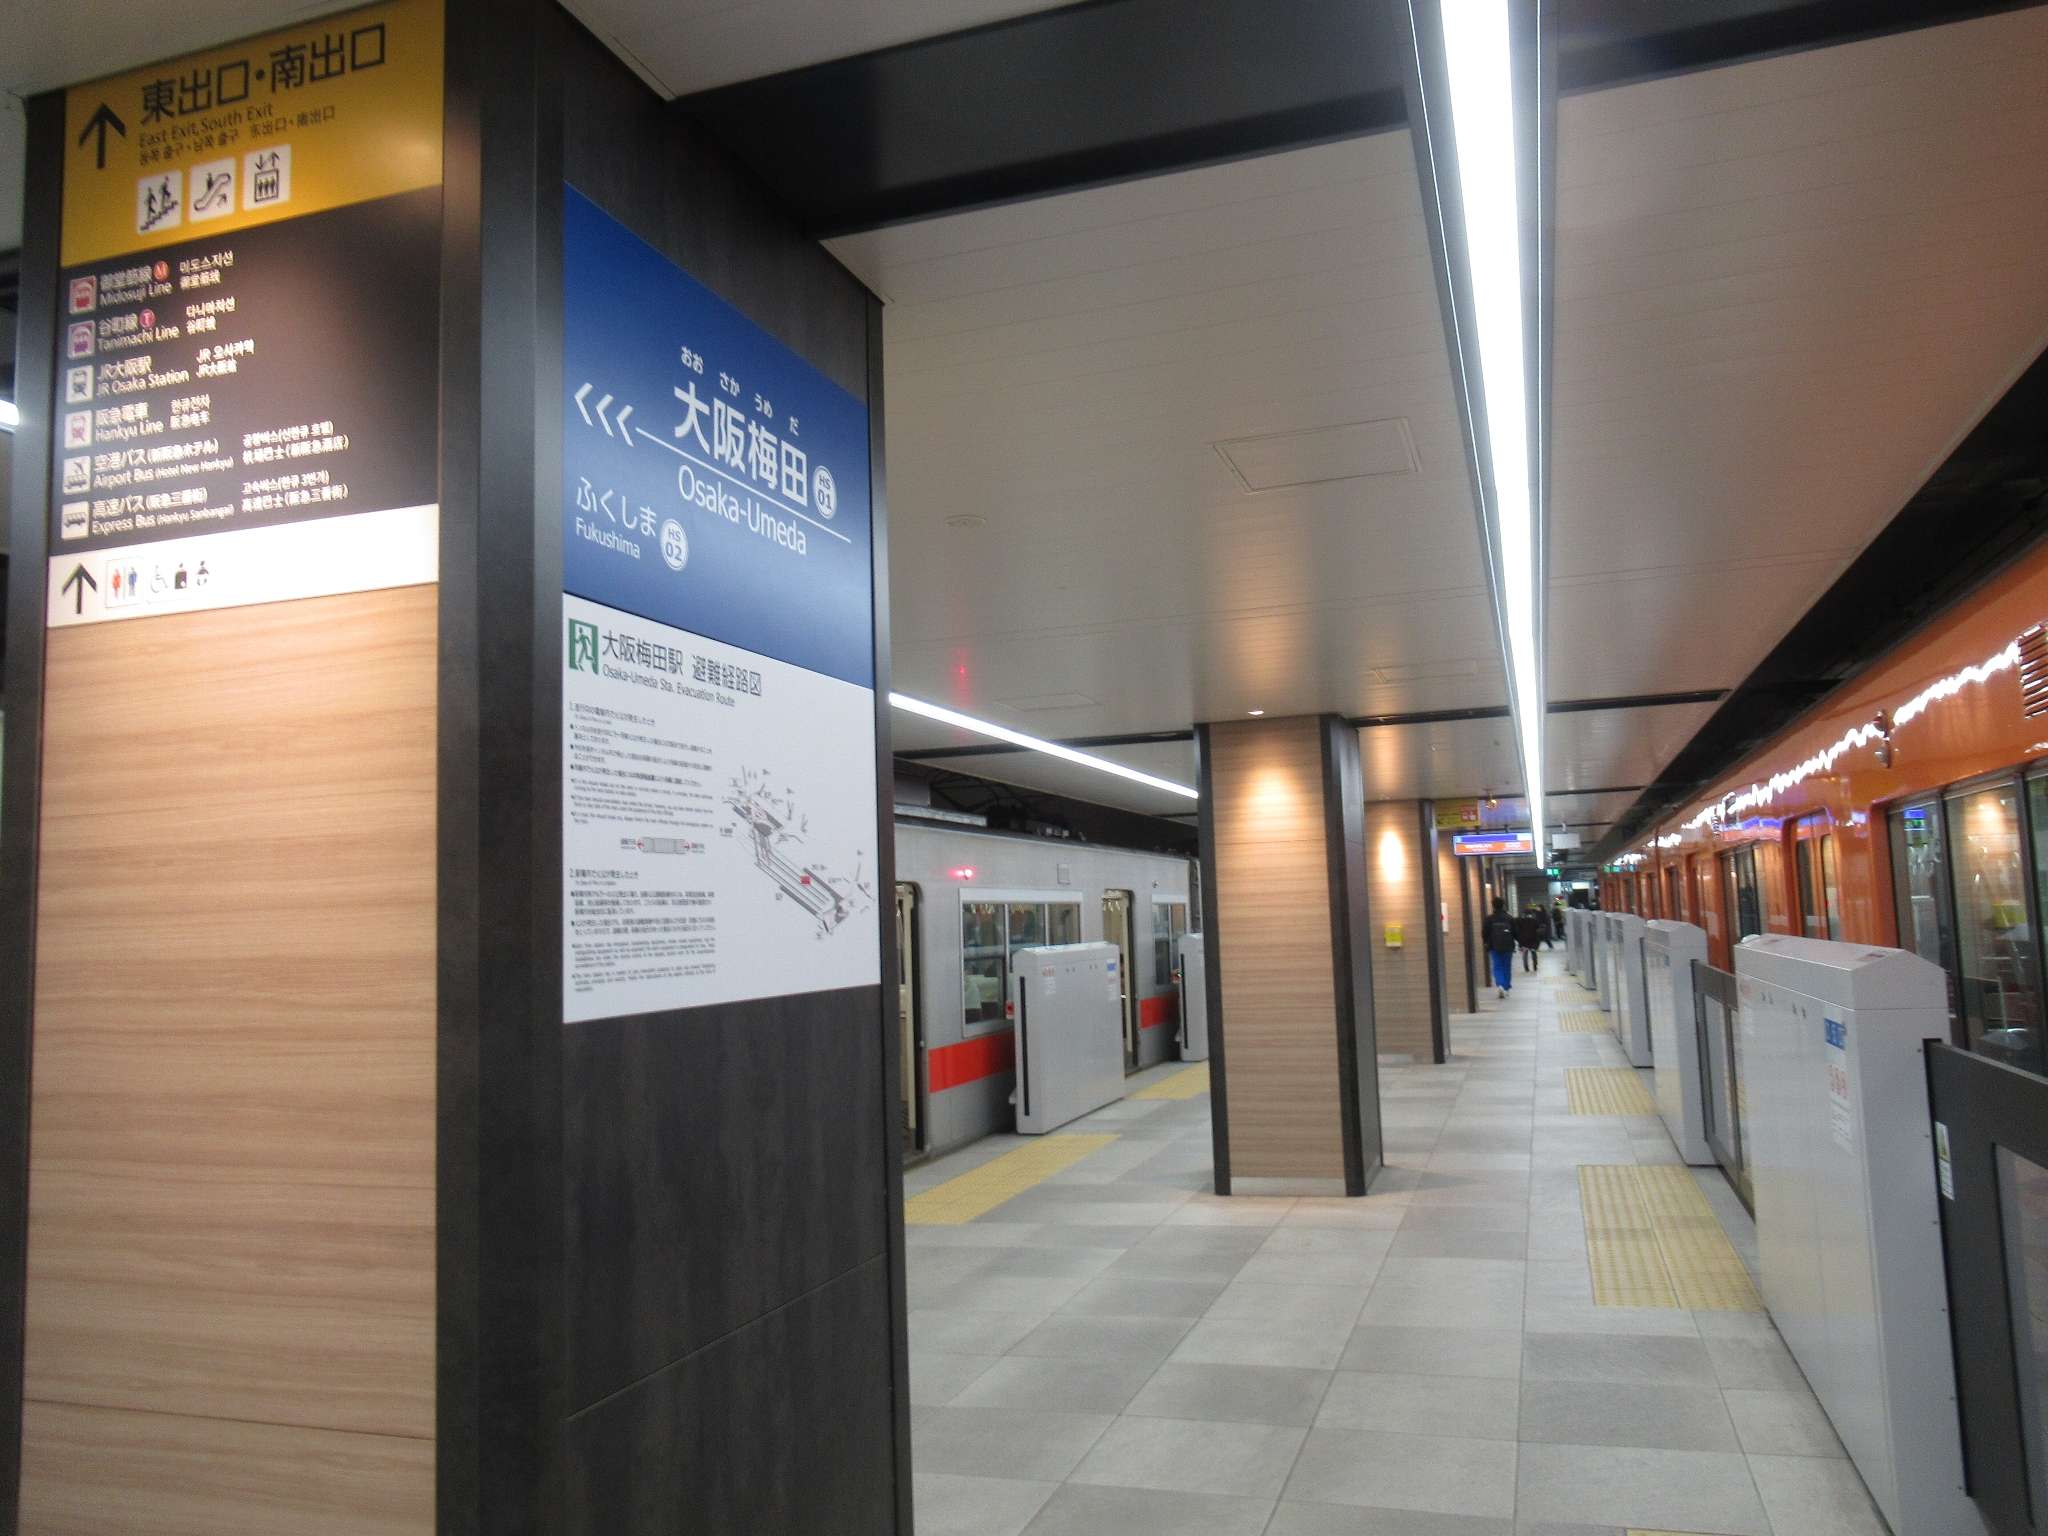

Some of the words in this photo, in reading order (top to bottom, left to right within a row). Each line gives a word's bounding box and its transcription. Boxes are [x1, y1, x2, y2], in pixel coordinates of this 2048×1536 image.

[140, 22, 386, 127] 東出口・南出口
[139, 129, 167, 149] East
[247, 102, 274, 122] Exit
[148, 281, 174, 298] Line
[97, 328, 153, 351] Tanimachi
[155, 325, 180, 341] Line
[196, 348, 211, 364] JR
[96, 381, 110, 398] JR
[111, 377, 147, 393] Osaka
[148, 369, 190, 389] Station
[681, 346, 704, 375] おお
[719, 371, 741, 397] さか
[755, 394, 774, 418] うめ
[789, 415, 800, 437] だ
[96, 424, 139, 442] Hankyu
[140, 419, 165, 436] Line
[674, 381, 808, 507] 大阪梅田
[93, 470, 133, 490] Airport
[134, 467, 155, 482] Bus
[818, 474, 832, 491] HS
[577, 476, 657, 537] ふくしま
[678, 464, 807, 556] Osaka-Umeda
[816, 489, 832, 511] 01
[92, 516, 134, 537] Express
[135, 513, 156, 528] Bus
[575, 516, 641, 560] Fukushima
[667, 527, 682, 542] HS
[665, 542, 683, 562] 02
[602, 629, 684, 677] 大阪梅田駅
[602, 663, 658, 688] Osaka-Umeda
[660, 677, 674, 692] Sta.
[677, 682, 715, 703] Evacuation
[716, 692, 736, 707] Route
